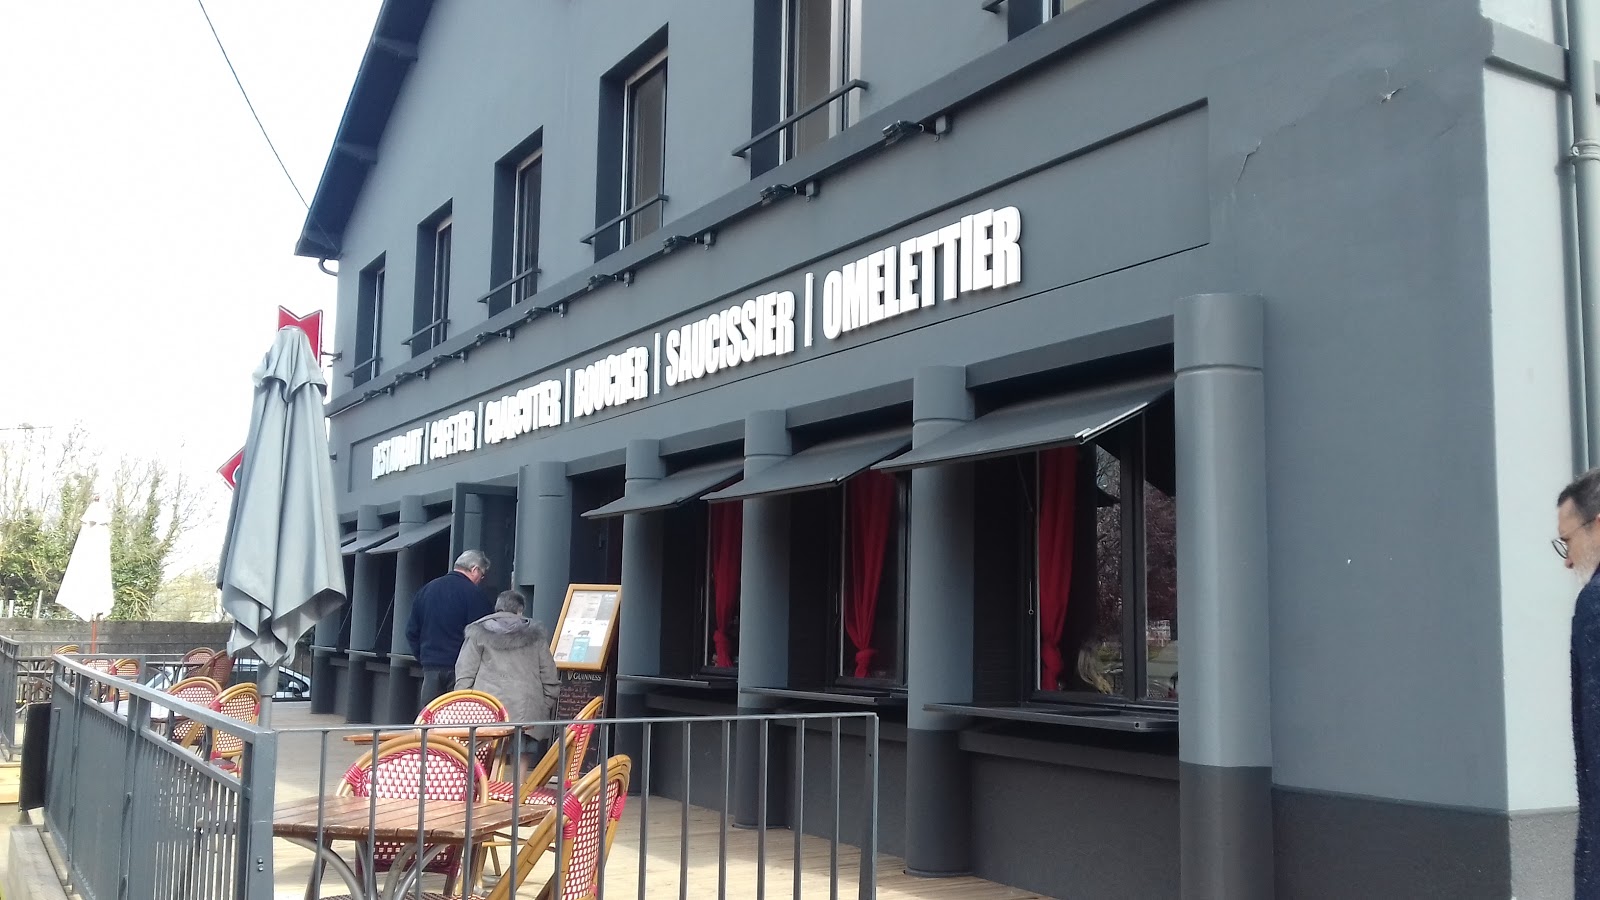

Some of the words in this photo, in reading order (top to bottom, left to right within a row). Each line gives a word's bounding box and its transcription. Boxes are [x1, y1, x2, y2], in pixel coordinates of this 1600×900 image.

[429, 410, 476, 460] CAFETIER
[484, 379, 562, 444] CHARCUTIER
[573, 346, 649, 418] BOUCHER
[665, 290, 795, 387] SAUCISSIER
[822, 206, 1021, 340] OMELETTIER
[573, 672, 602, 681] GUINNESS
